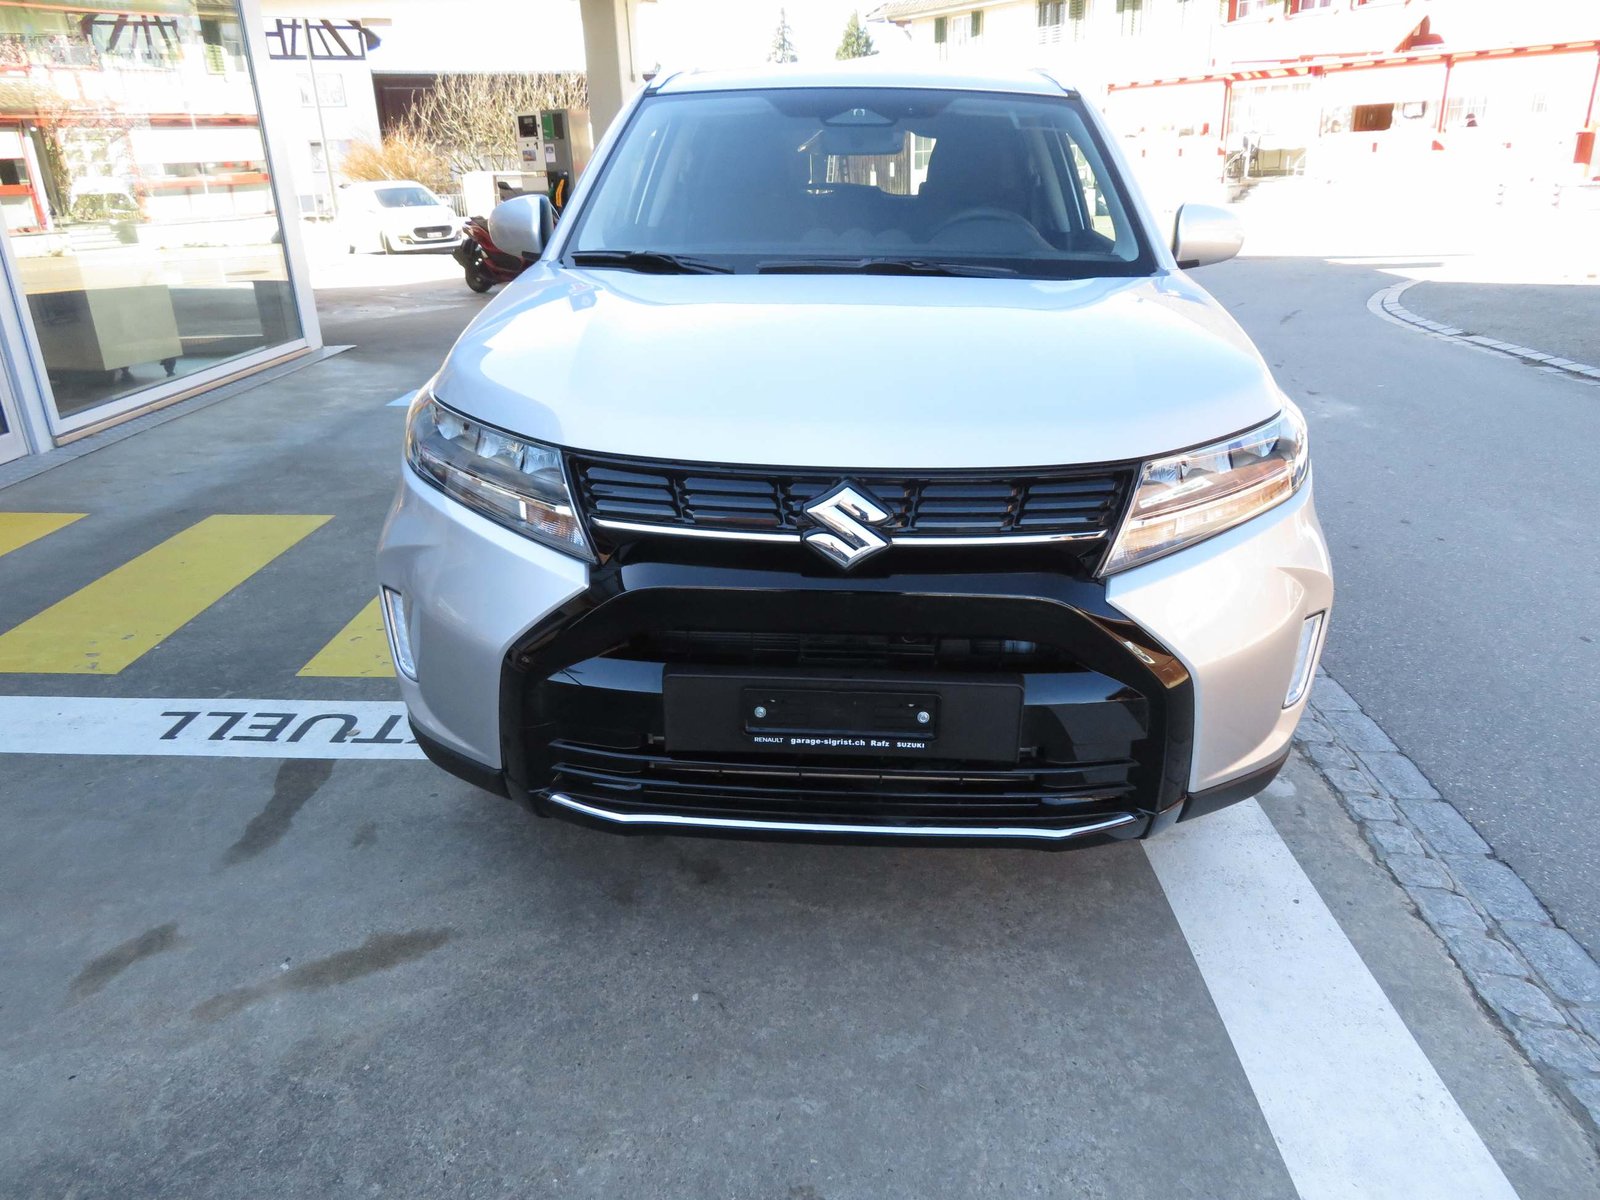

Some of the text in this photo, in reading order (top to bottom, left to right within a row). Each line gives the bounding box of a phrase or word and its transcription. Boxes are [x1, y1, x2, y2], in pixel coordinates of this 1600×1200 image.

[159, 711, 418, 744] TUELL
[790, 738, 866, 746] garage-sigrist.ch
[870, 739, 890, 747] Rafz
